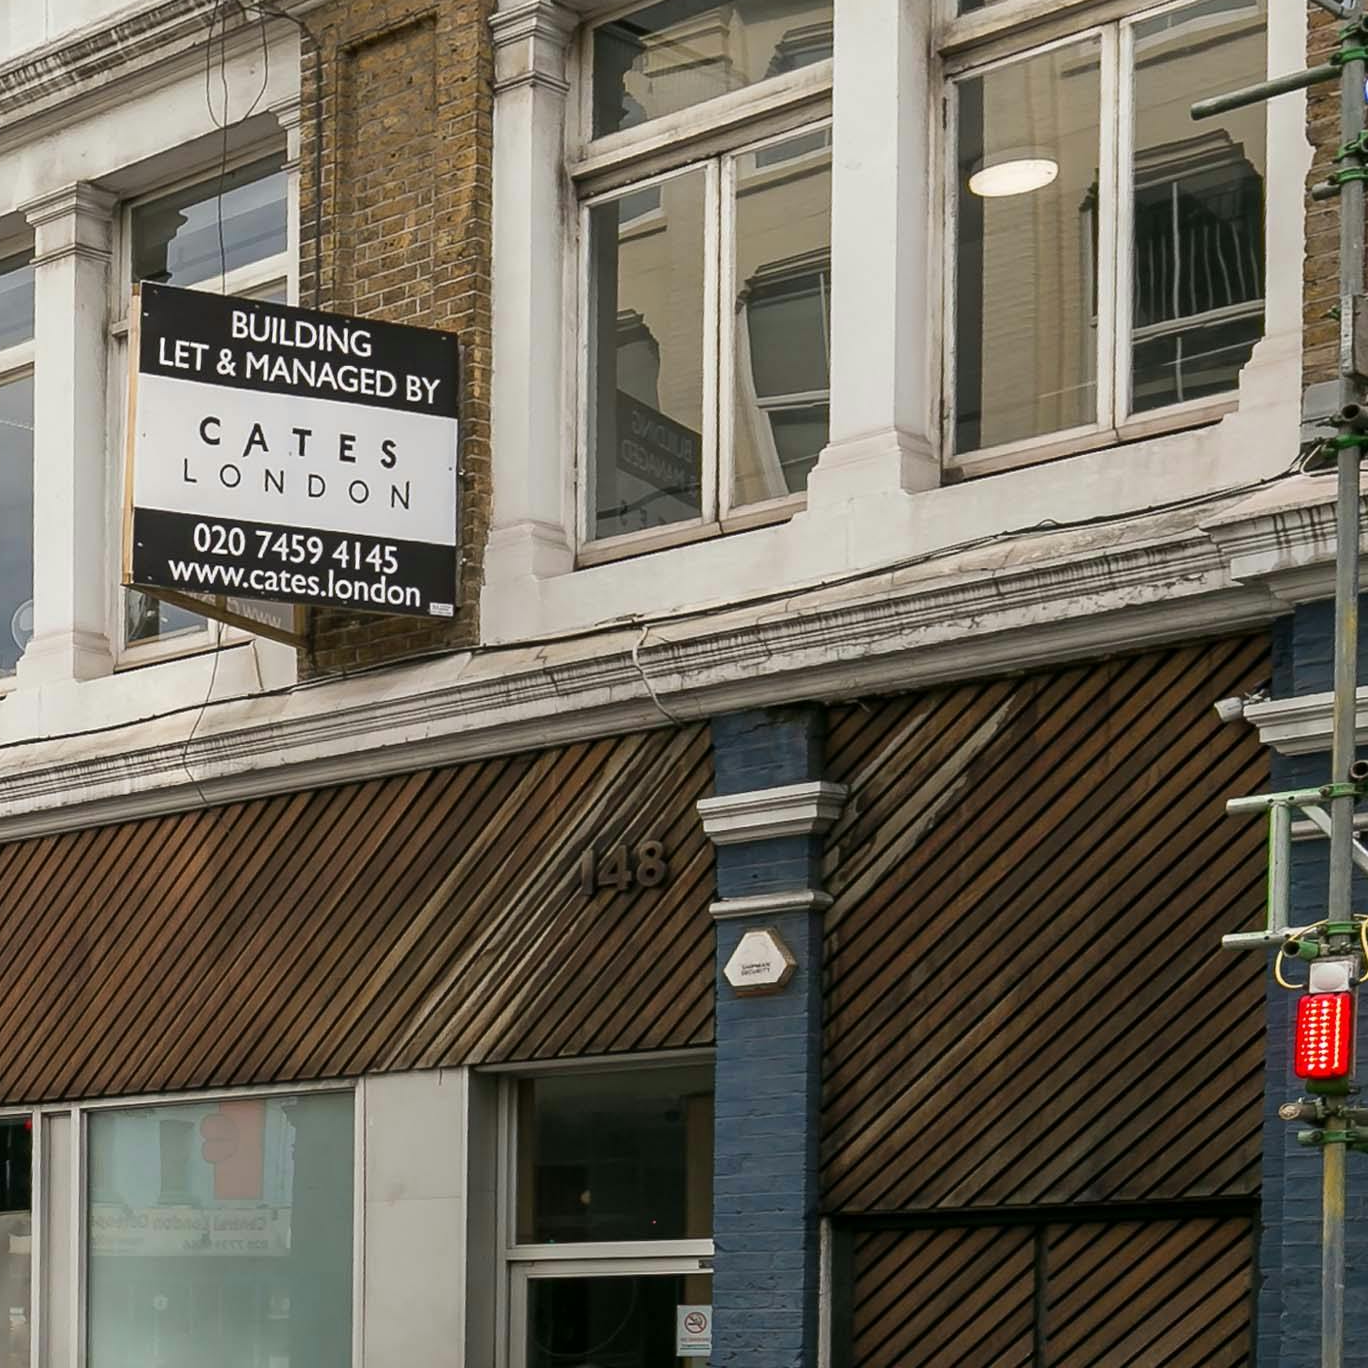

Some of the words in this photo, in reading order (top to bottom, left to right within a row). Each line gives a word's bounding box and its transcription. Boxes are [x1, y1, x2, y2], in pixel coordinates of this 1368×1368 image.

[232, 311, 371, 357] BUILDING
[159, 337, 209, 371] LET
[216, 349, 237, 377] &
[245, 354, 396, 397] MANAGED
[406, 375, 440, 404] BY
[199, 416, 397, 469] CATES
[184, 458, 410, 510] LONDON
[193, 522, 246, 556] 020
[255, 530, 323, 564] 7459
[332, 540, 399, 574] 4145
[168, 559, 421, 607] www.cates.london
[581, 840, 667, 895] 148
